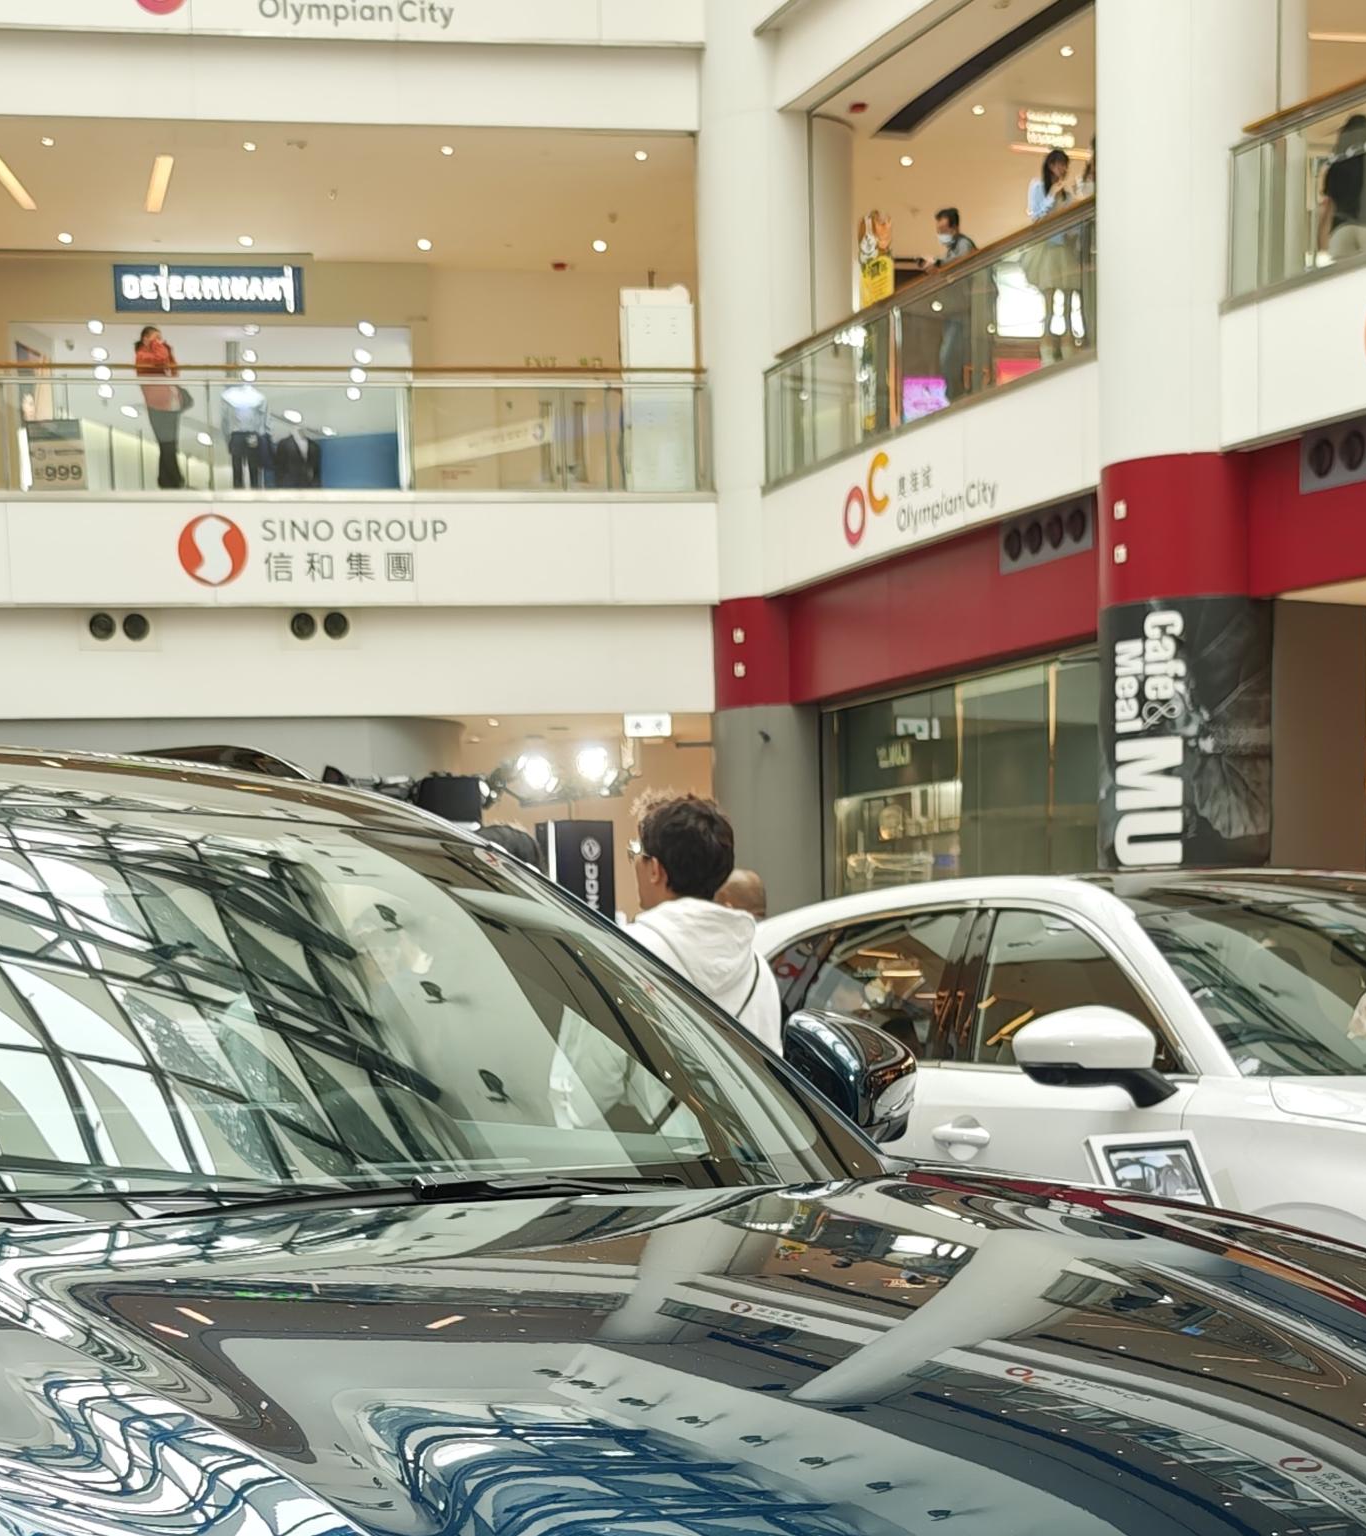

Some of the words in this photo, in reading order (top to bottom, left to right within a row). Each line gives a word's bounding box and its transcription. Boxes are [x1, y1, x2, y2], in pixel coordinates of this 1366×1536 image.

[258, 0, 392, 26] Olympian
[399, 0, 455, 29] City
[122, 264, 296, 314] DETERMINANT
[45, 464, 83, 482] 999
[261, 518, 335, 543] SINO
[343, 518, 448, 544] GROUP
[264, 552, 415, 584] 信和集團
[1115, 638, 1145, 734] Meal
[1115, 736, 1184, 872] MU
